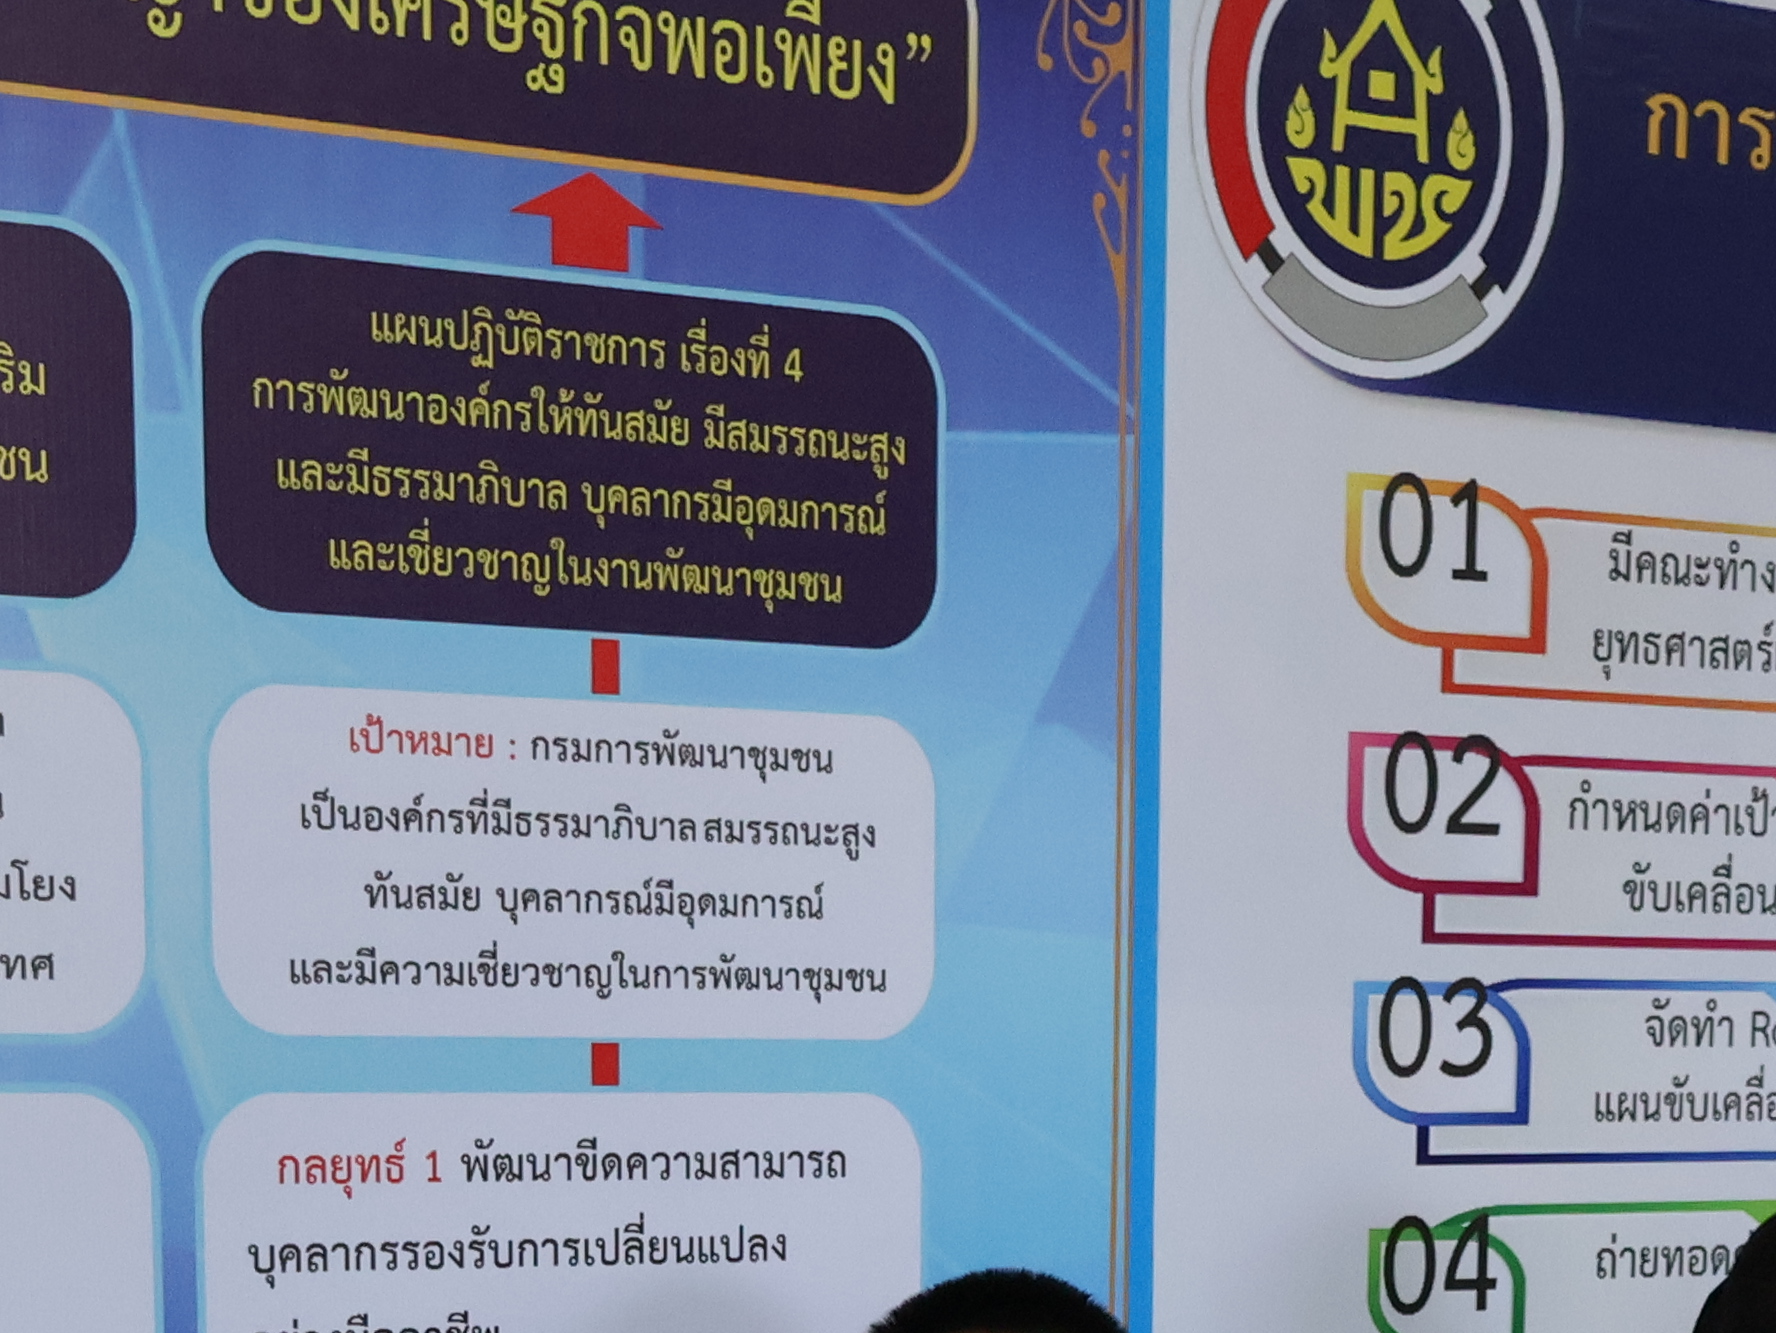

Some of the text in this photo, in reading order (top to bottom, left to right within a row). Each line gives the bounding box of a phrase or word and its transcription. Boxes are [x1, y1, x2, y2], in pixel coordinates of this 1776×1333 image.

[369, 303, 805, 384] แผนปฏิบัติราชการ เรื่องที่ 4
[252, 374, 908, 480] การพัฒนาองค์กรให้ทันสมัย มีสมรรถนะสูง
[276, 451, 888, 539] และมีธรรมาภิบาล บุคลากรมีอุดมการณ์
[1378, 471, 1488, 582] 01
[327, 518, 844, 615] และเชี่ยวชาญในงานพัฒนาชุมชน
[348, 712, 495, 762] เป้าหมาย
[529, 728, 834, 782] กรมการพัฒนาชุมชน
[1383, 730, 1502, 838] 02
[364, 869, 824, 929] ทันสมัย บุคลากรณ์มีอุดมการณ์
[289, 941, 887, 1003] และมีความเชี่ยวชาญในการพัฒนาชุมชน
[1378, 976, 1494, 1080] 03
[1644, 998, 1736, 1052] จัดทำ
[276, 1137, 848, 1199] กลยุทธ์ 1 พัฒนาขีดความสามารถ
[248, 1212, 788, 1291] บุคลากรรองรับการเปลี่ยนแปลง
[1383, 1212, 1499, 1316] 04
